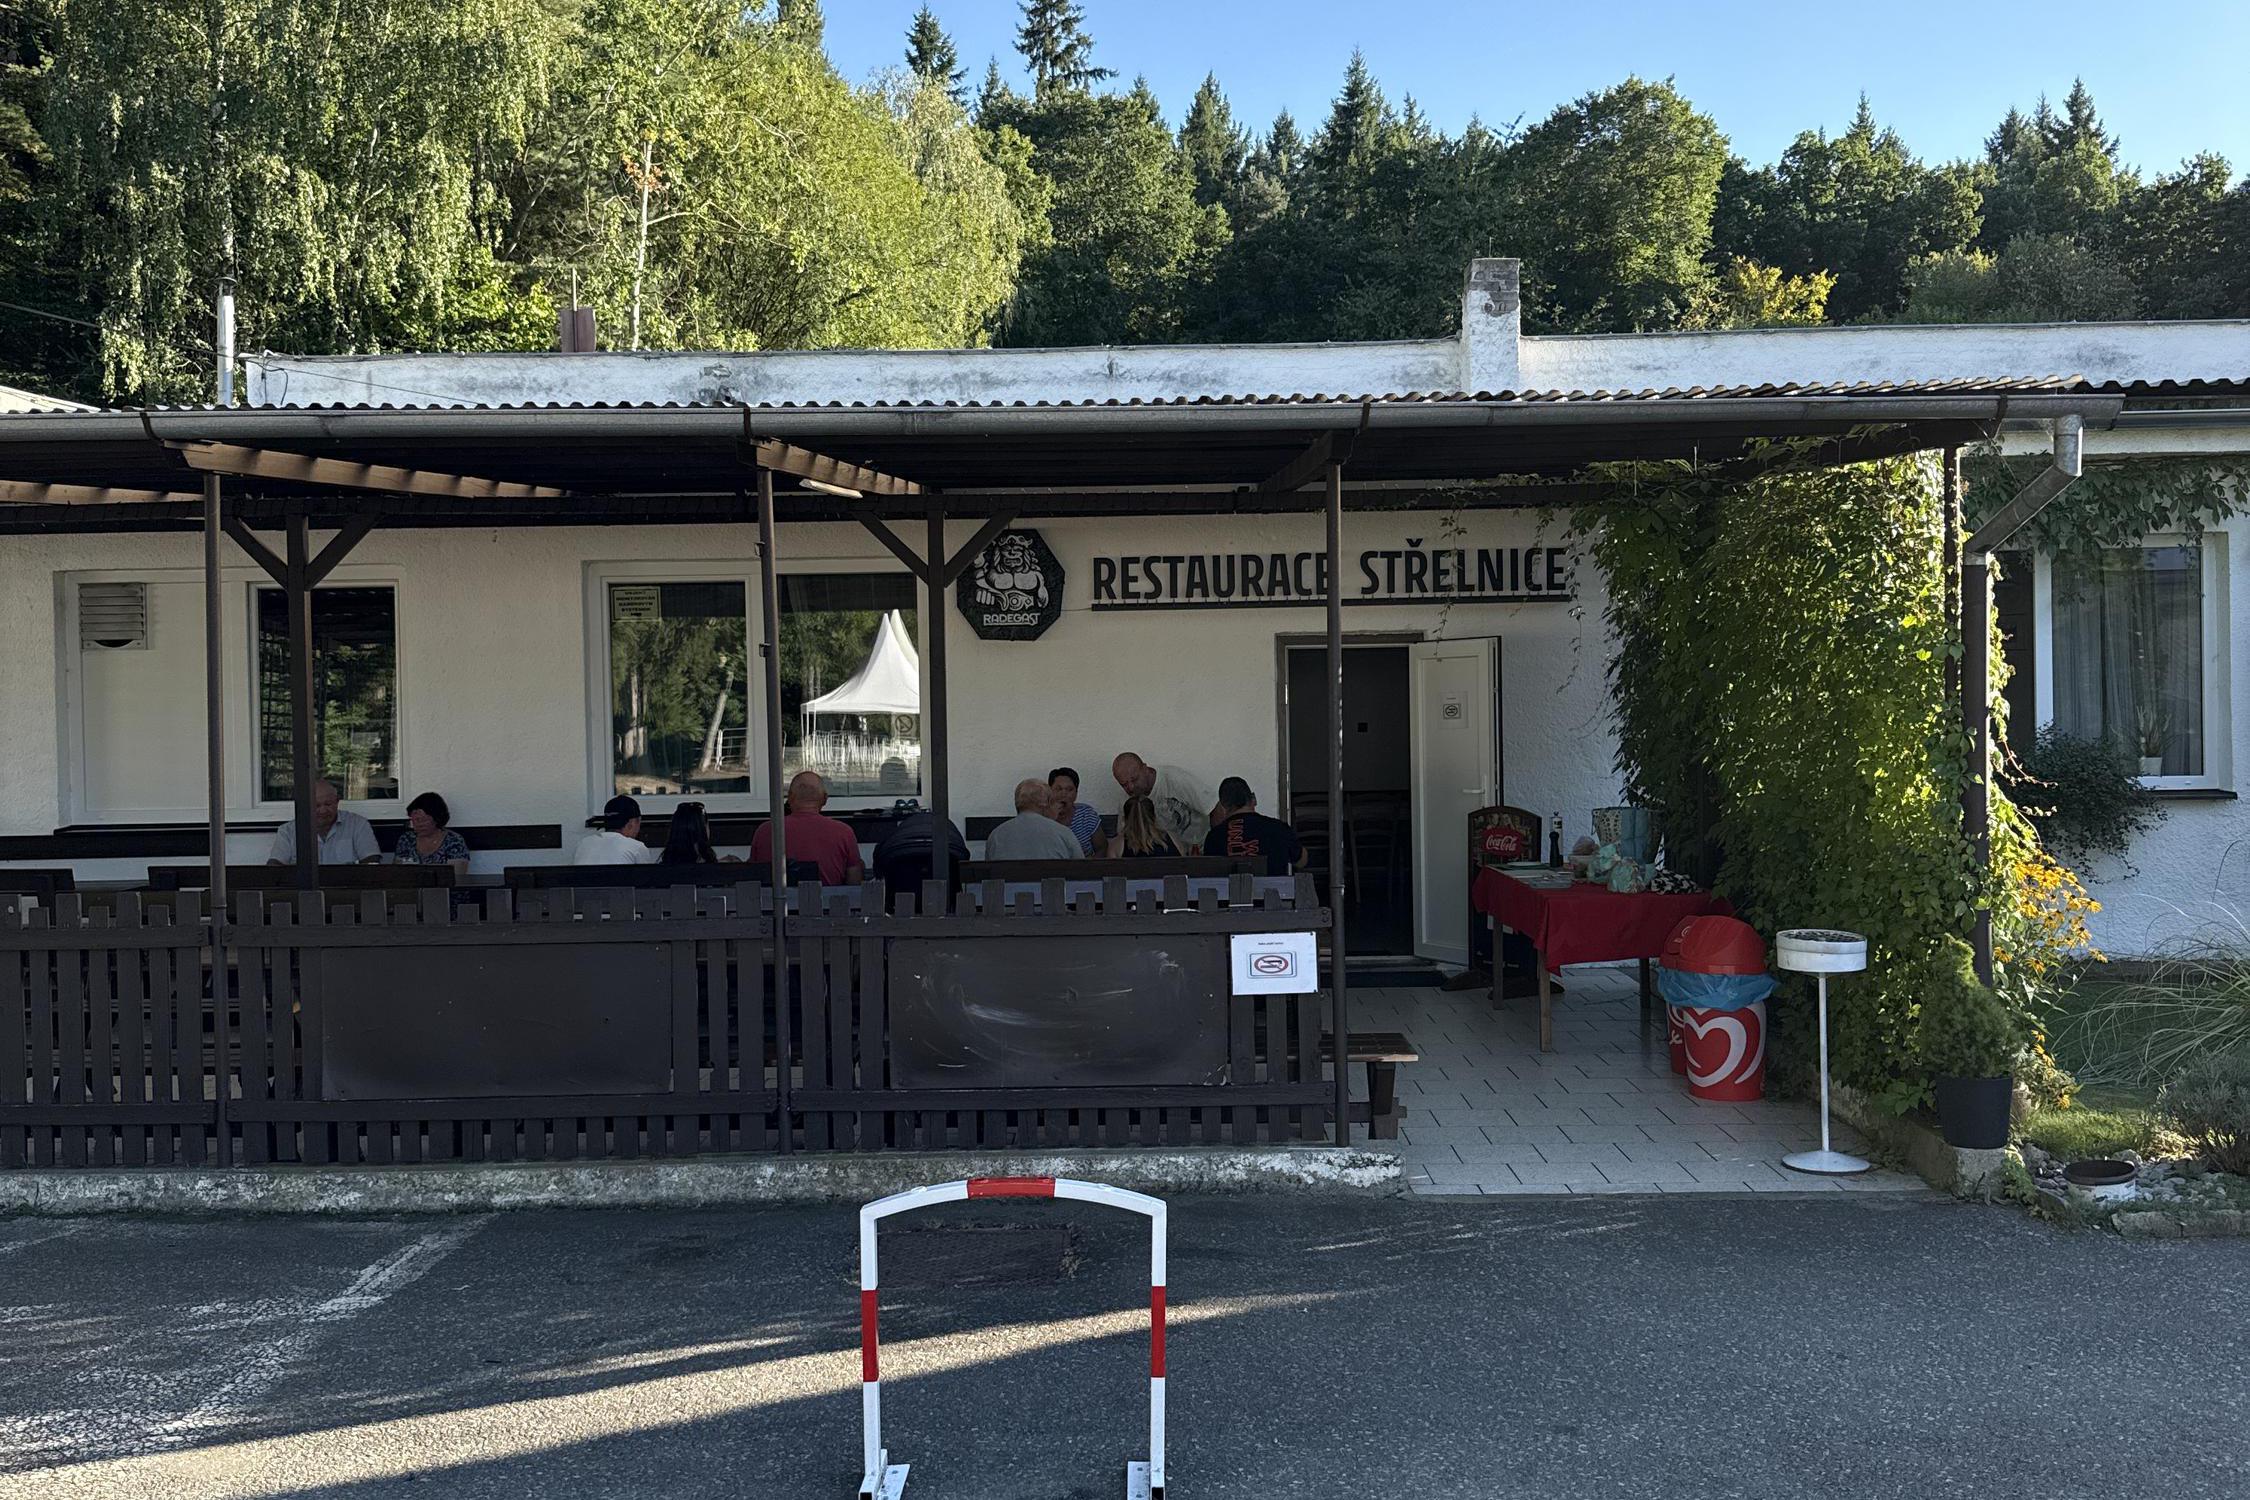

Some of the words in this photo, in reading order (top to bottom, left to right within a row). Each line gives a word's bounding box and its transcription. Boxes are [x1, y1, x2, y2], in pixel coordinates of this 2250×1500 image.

[1093, 552, 1328, 600] RESTAURACE
[1360, 538, 1567, 595] STŘELNICE
[983, 612, 1041, 626] RADEGAST
